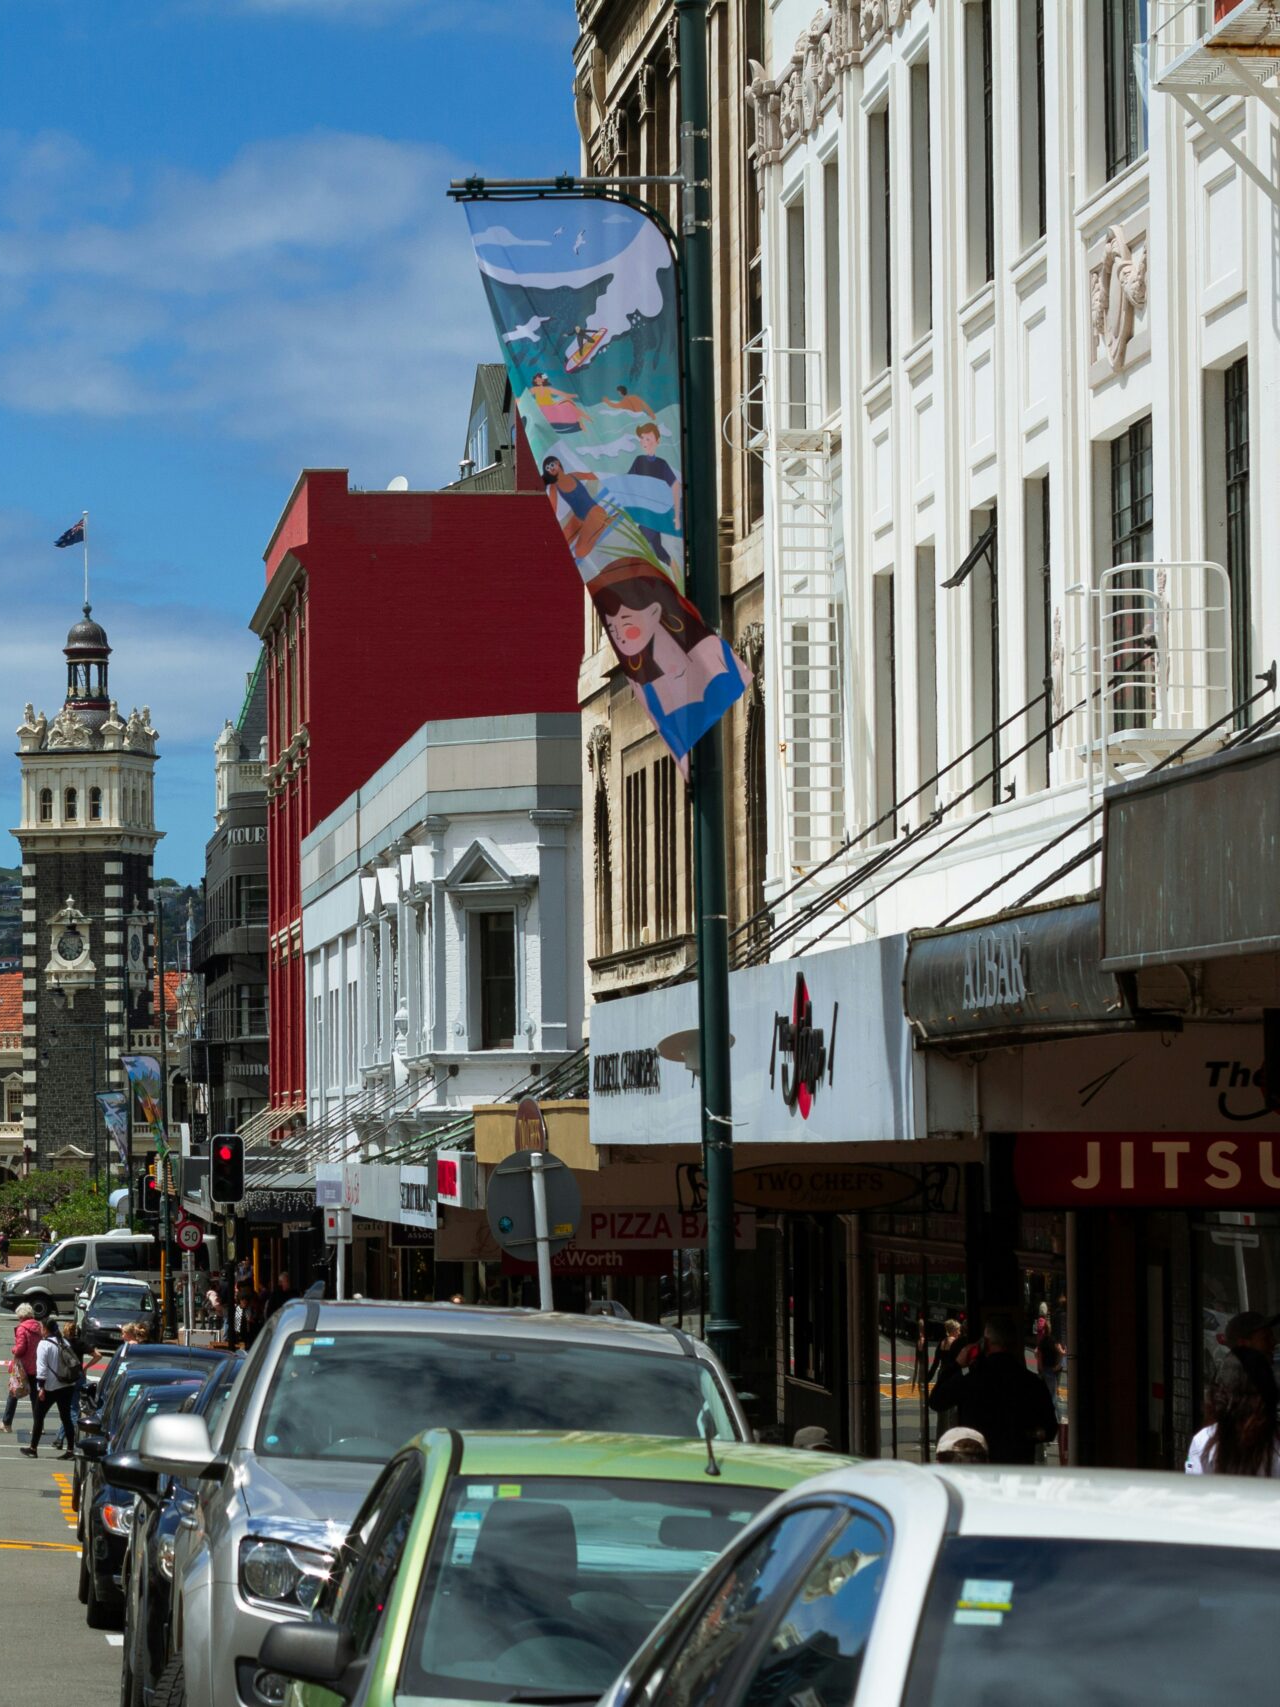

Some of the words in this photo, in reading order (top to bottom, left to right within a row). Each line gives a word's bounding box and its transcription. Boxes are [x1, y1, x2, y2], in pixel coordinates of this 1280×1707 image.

[962, 933, 1027, 1010] ALBAR
[1071, 1140, 1280, 1190] JITSU
[754, 1171, 803, 1190] TWO
[811, 1172, 882, 1191] CHEFS
[185, 1231, 198, 1242] 50
[591, 1213, 673, 1240] PIZZA
